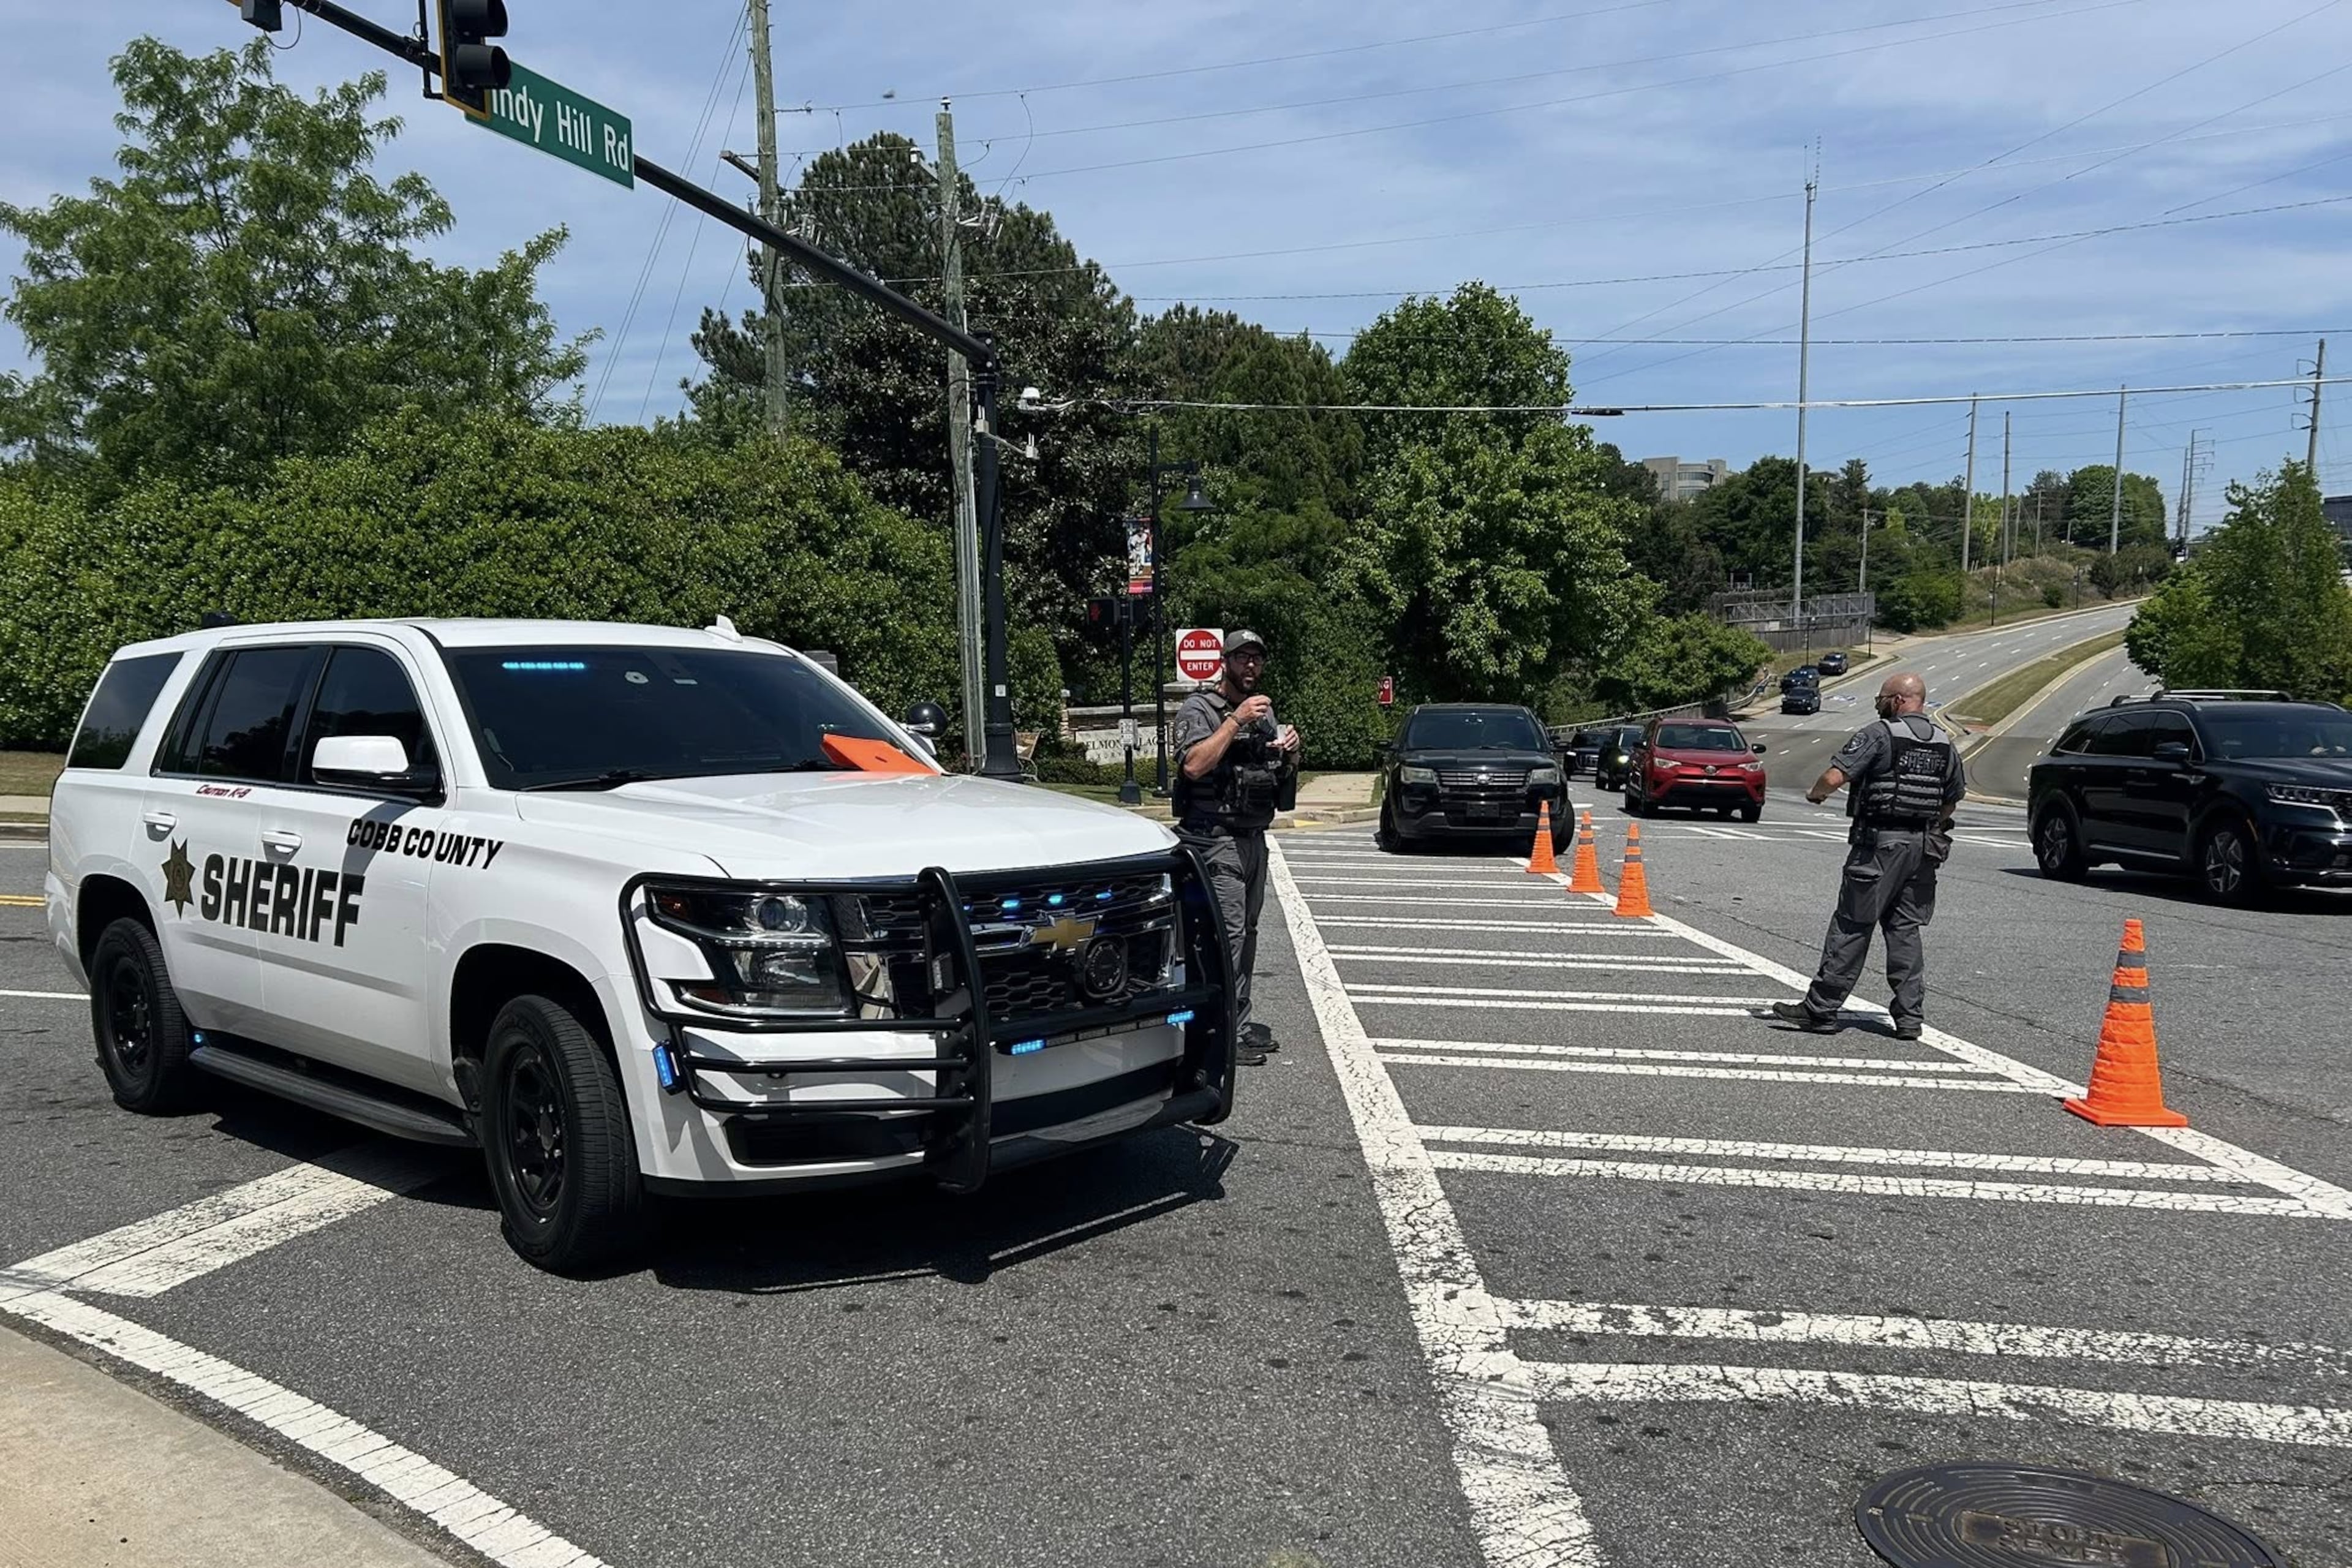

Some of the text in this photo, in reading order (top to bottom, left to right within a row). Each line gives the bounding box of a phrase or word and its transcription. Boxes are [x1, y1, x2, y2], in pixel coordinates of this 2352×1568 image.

[491, 85, 629, 172] ndy Hill Rd
[1183, 639, 1216, 649] DO NOT
[1187, 662, 1213, 671] ENTER
[1899, 755, 1946, 771] SHERIFF
[346, 818, 504, 870] COBB COUNTY
[201, 853, 366, 948] SHERIFF
